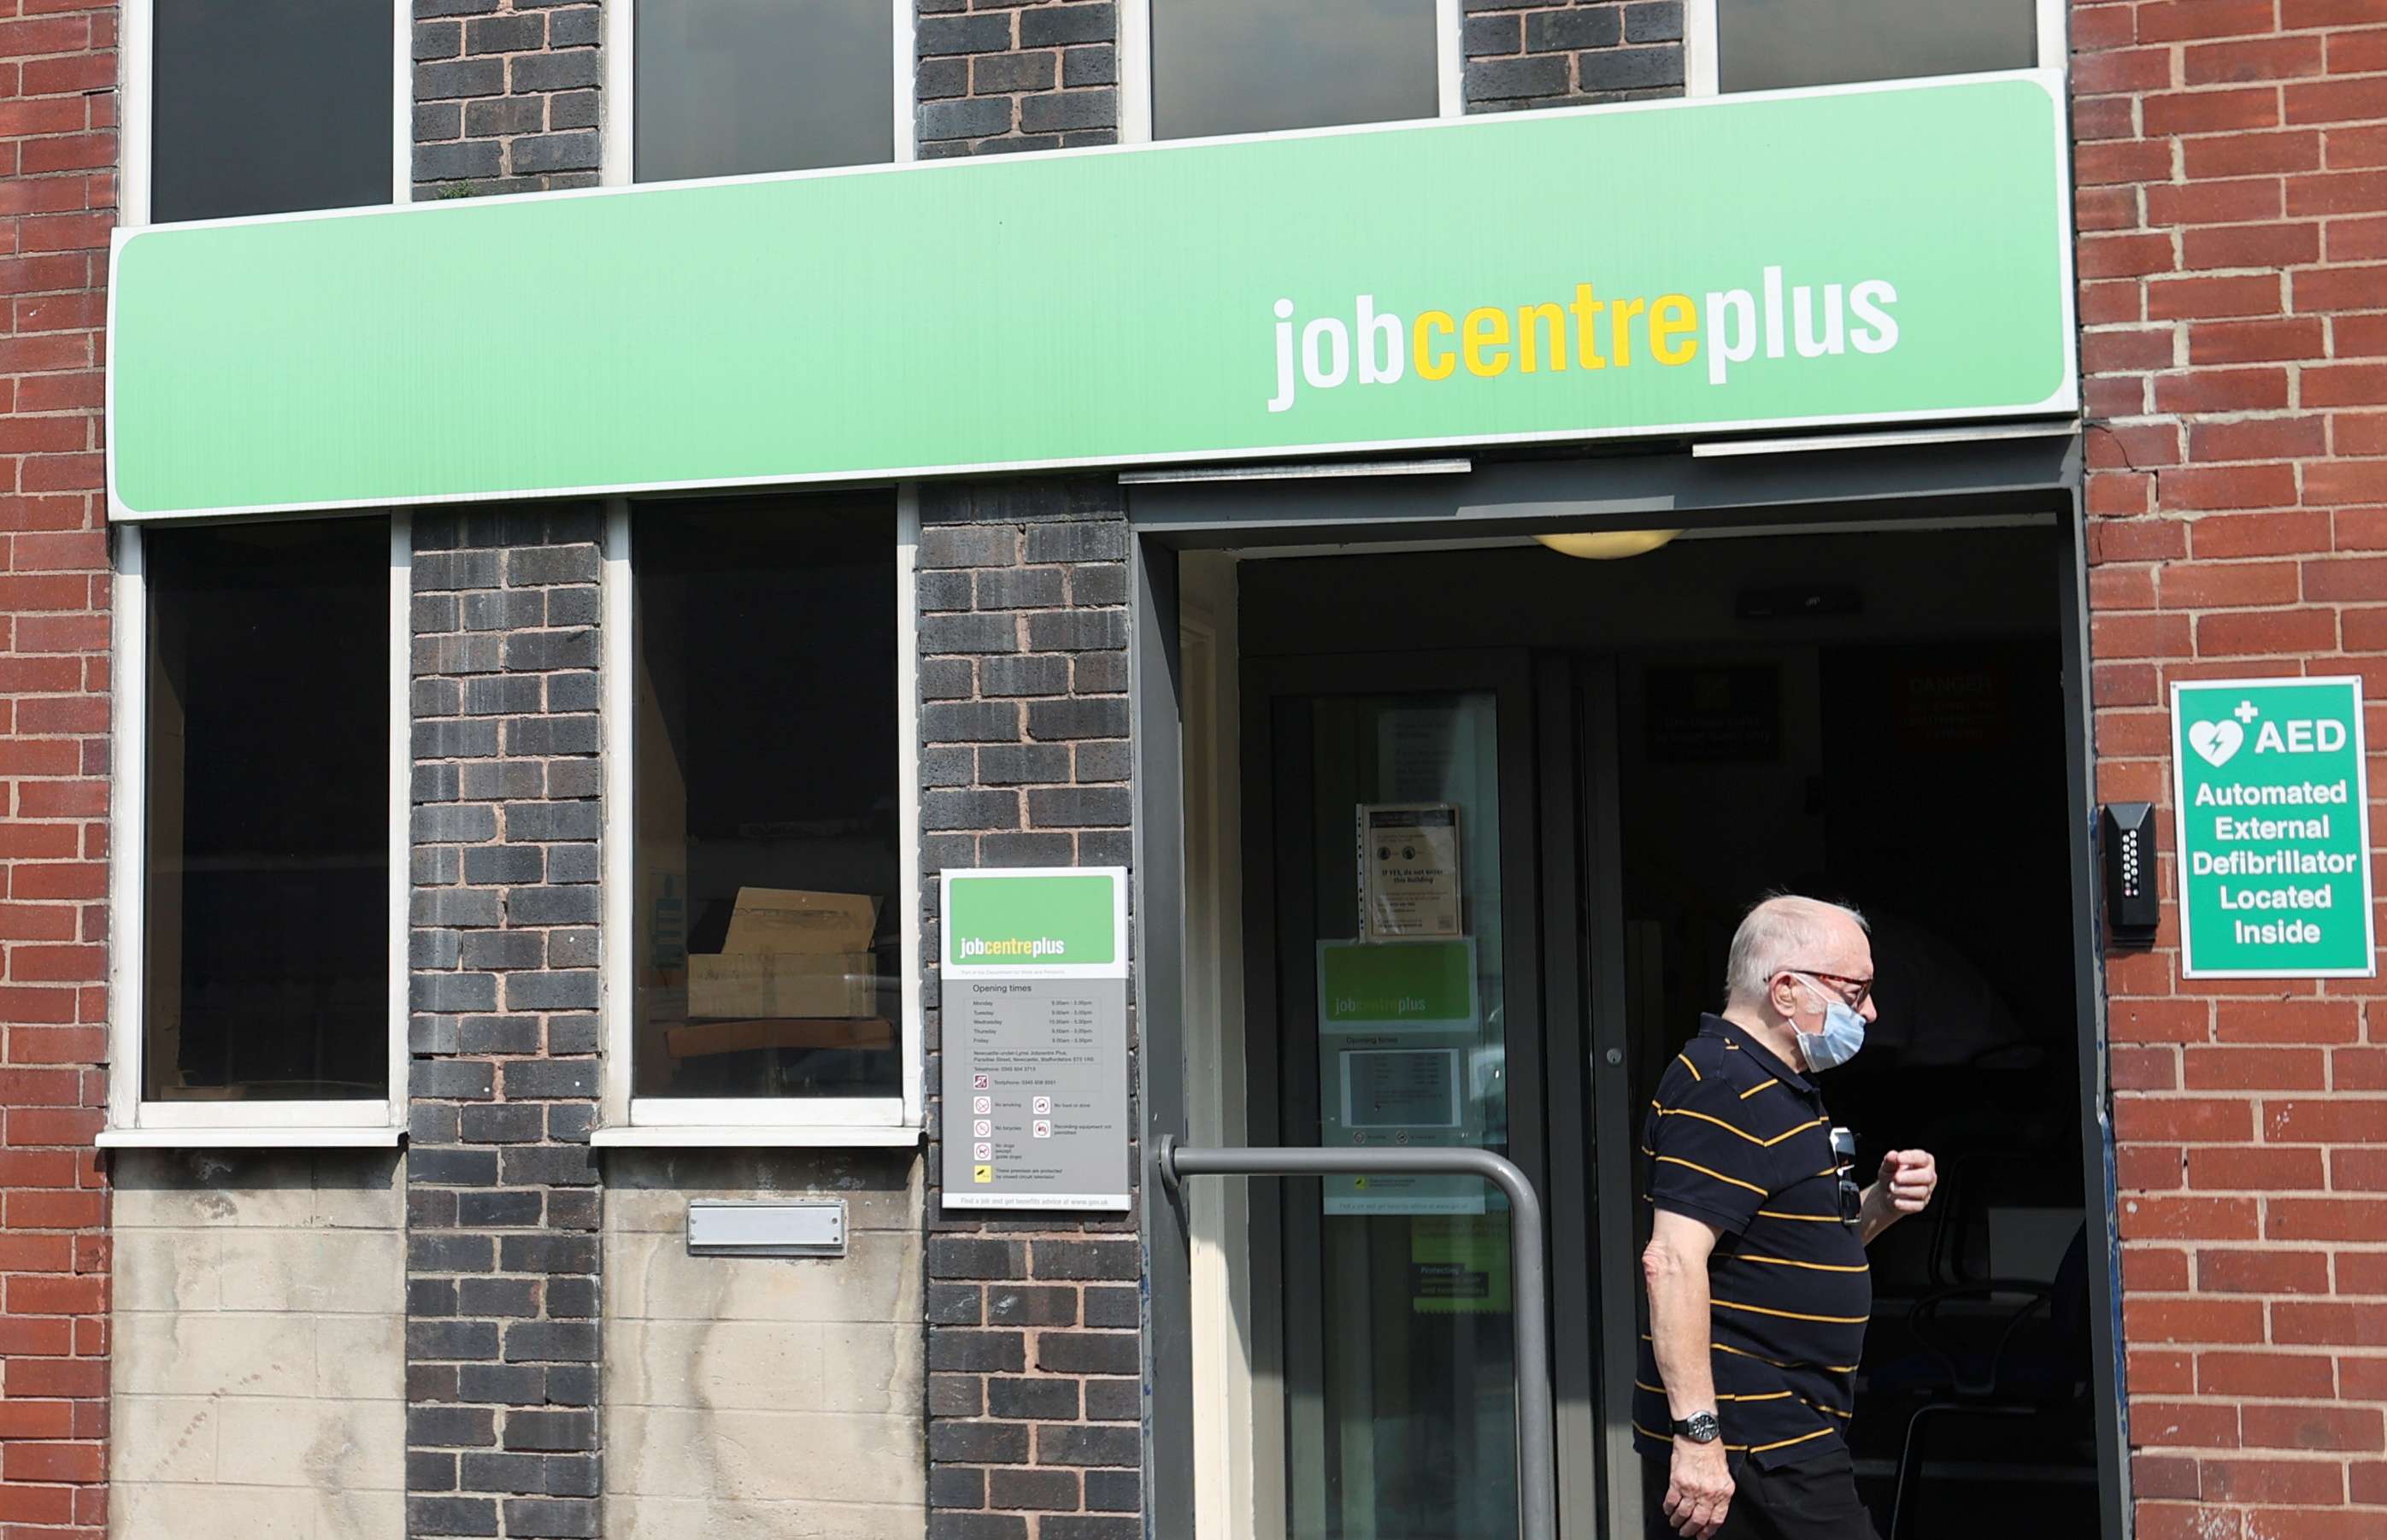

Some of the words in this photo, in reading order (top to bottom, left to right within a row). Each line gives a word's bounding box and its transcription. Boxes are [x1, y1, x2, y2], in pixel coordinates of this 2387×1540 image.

[1267, 266, 1899, 412] jobcentreplus
[2255, 719, 2347, 754] AED
[2195, 779, 2348, 807] Automated
[2215, 814, 2330, 841] External
[2193, 849, 2357, 876] Defibrillator
[2220, 885, 2332, 909] Located
[2235, 919, 2321, 944] Inside
[960, 937, 1065, 959] jobcentreplus
[973, 985, 1008, 994] Opening
[1009, 984, 1032, 992] times
